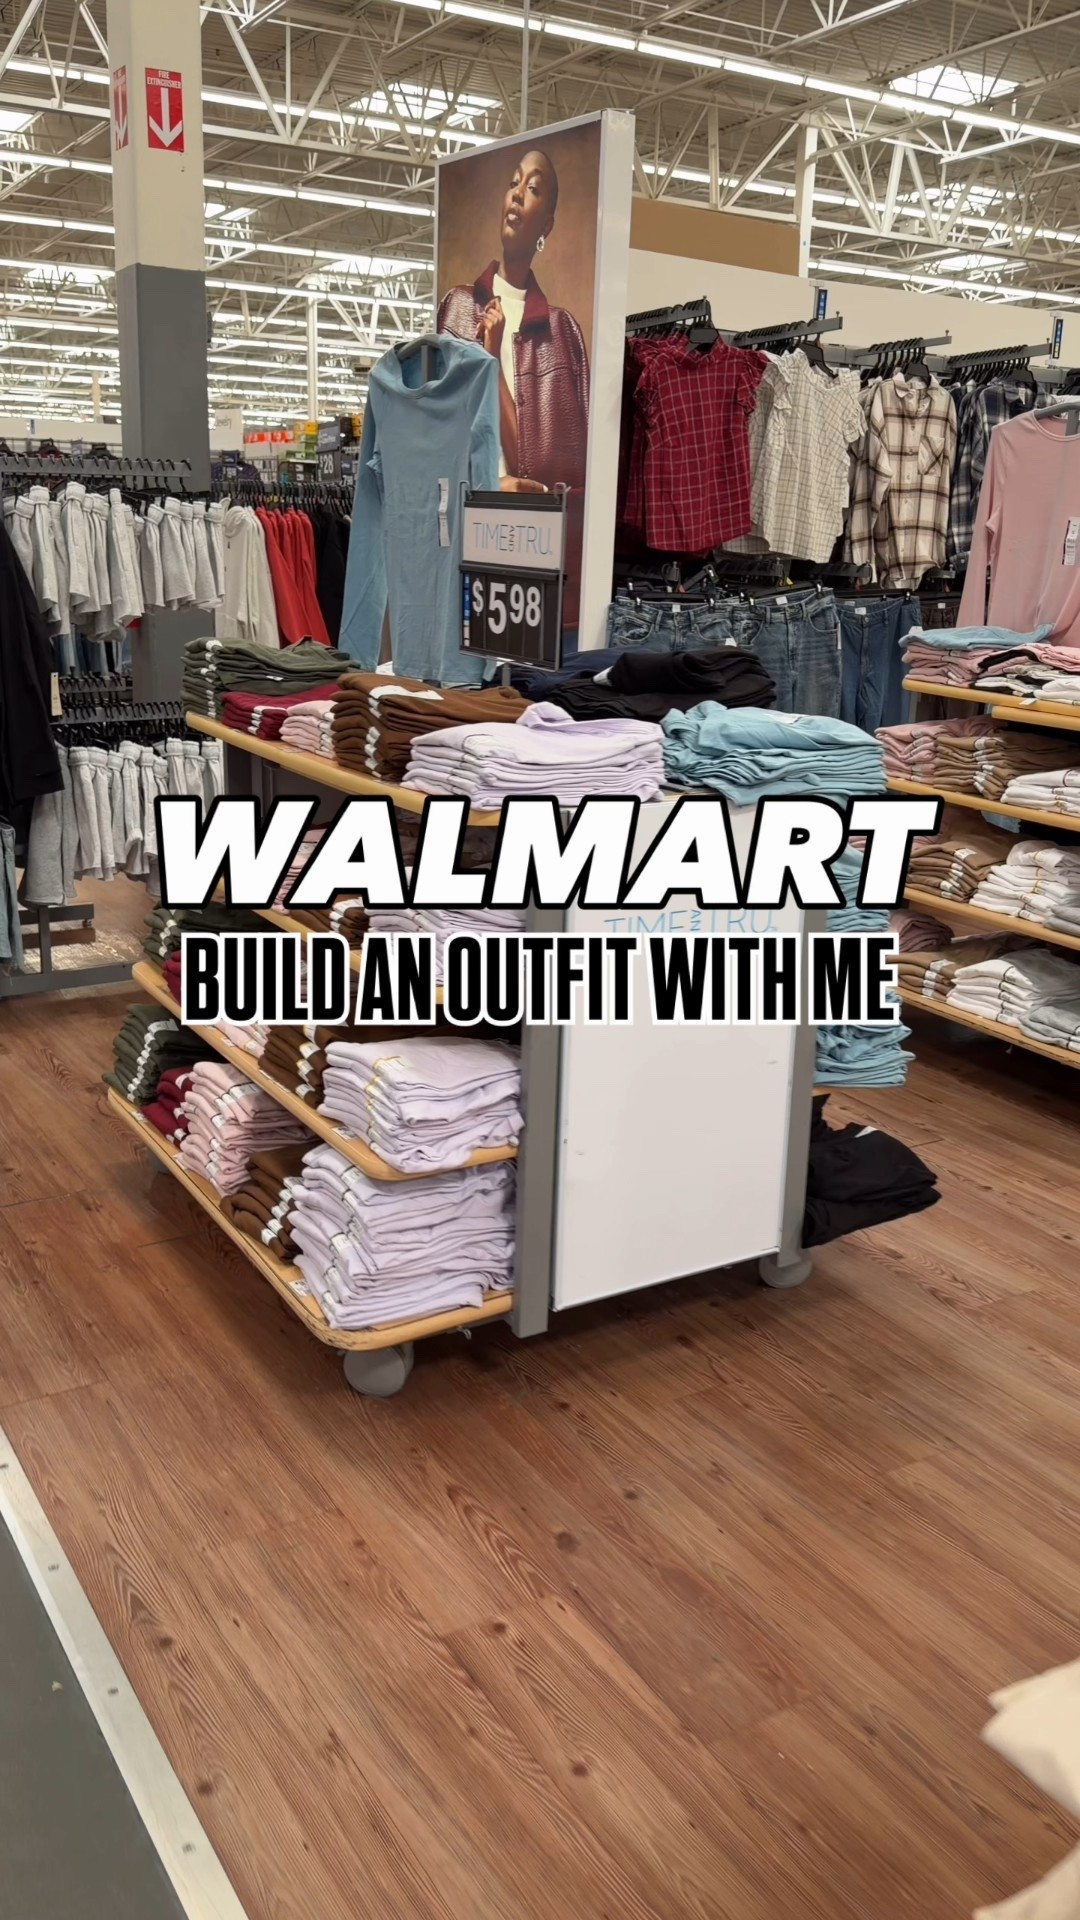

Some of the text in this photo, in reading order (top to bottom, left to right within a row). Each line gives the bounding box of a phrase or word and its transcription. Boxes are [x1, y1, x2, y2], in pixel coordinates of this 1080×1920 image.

[158, 70, 170, 80] FIRE
[147, 77, 181, 89] EXTINGUISHER
[473, 522, 507, 550] TIME
